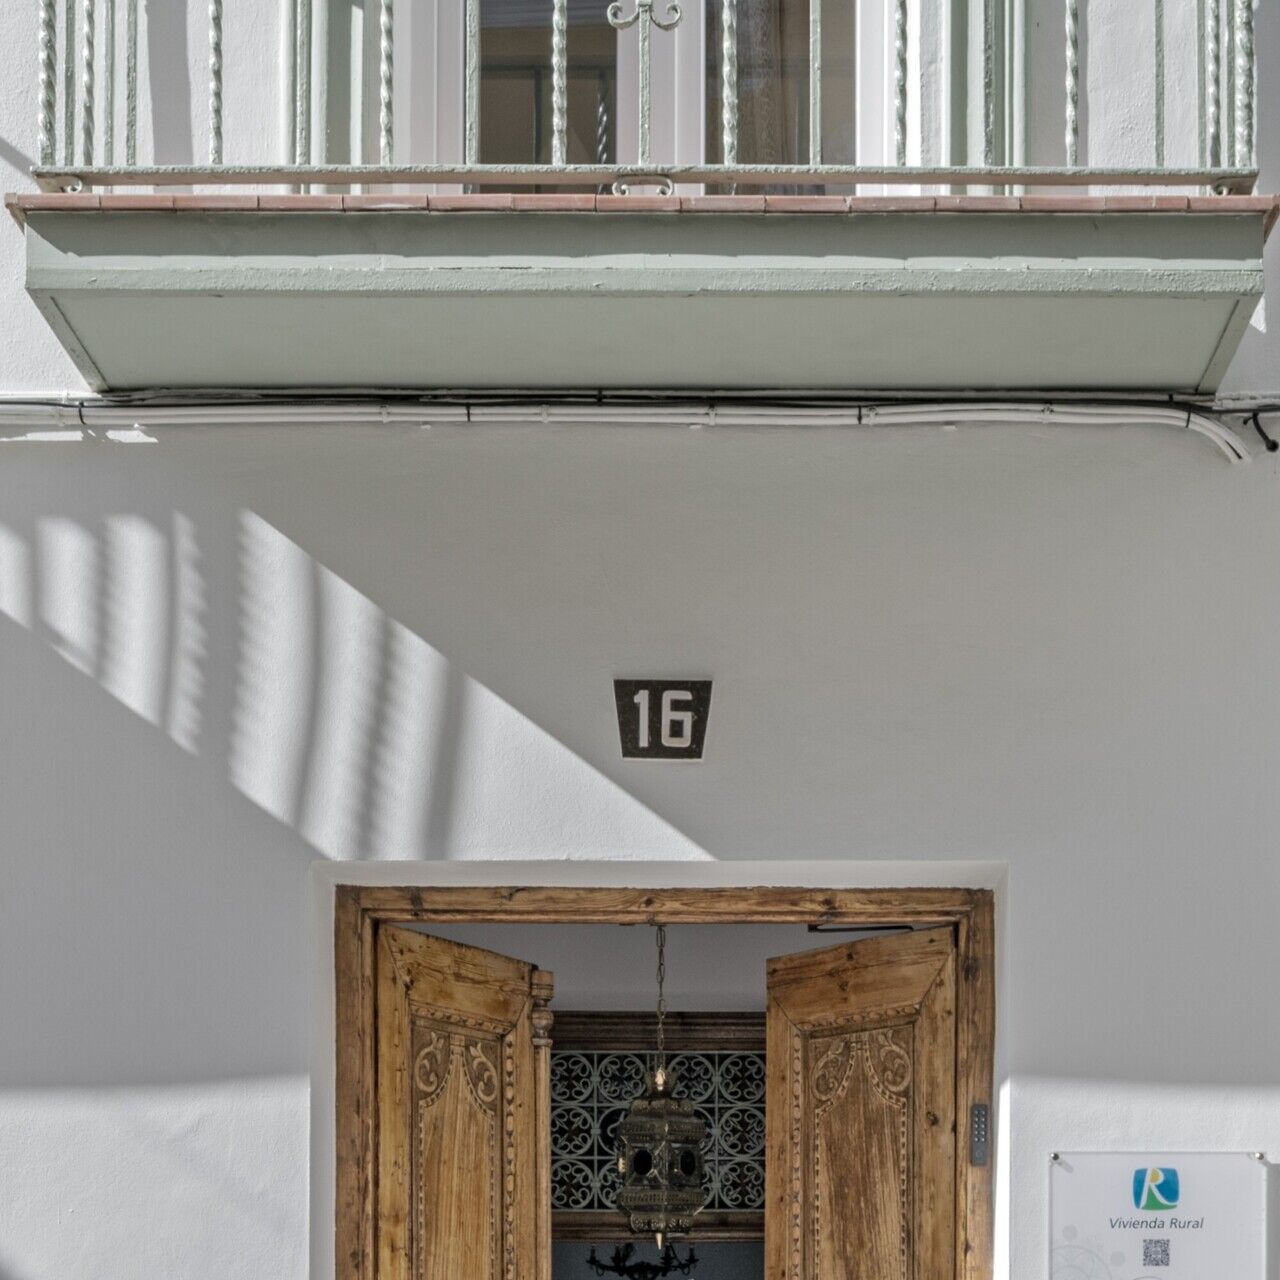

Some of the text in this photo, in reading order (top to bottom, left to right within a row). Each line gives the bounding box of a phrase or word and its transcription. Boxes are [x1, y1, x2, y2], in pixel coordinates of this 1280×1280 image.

[633, 689, 693, 748] 16
[1109, 1217, 1204, 1229] Vivienda Rural
